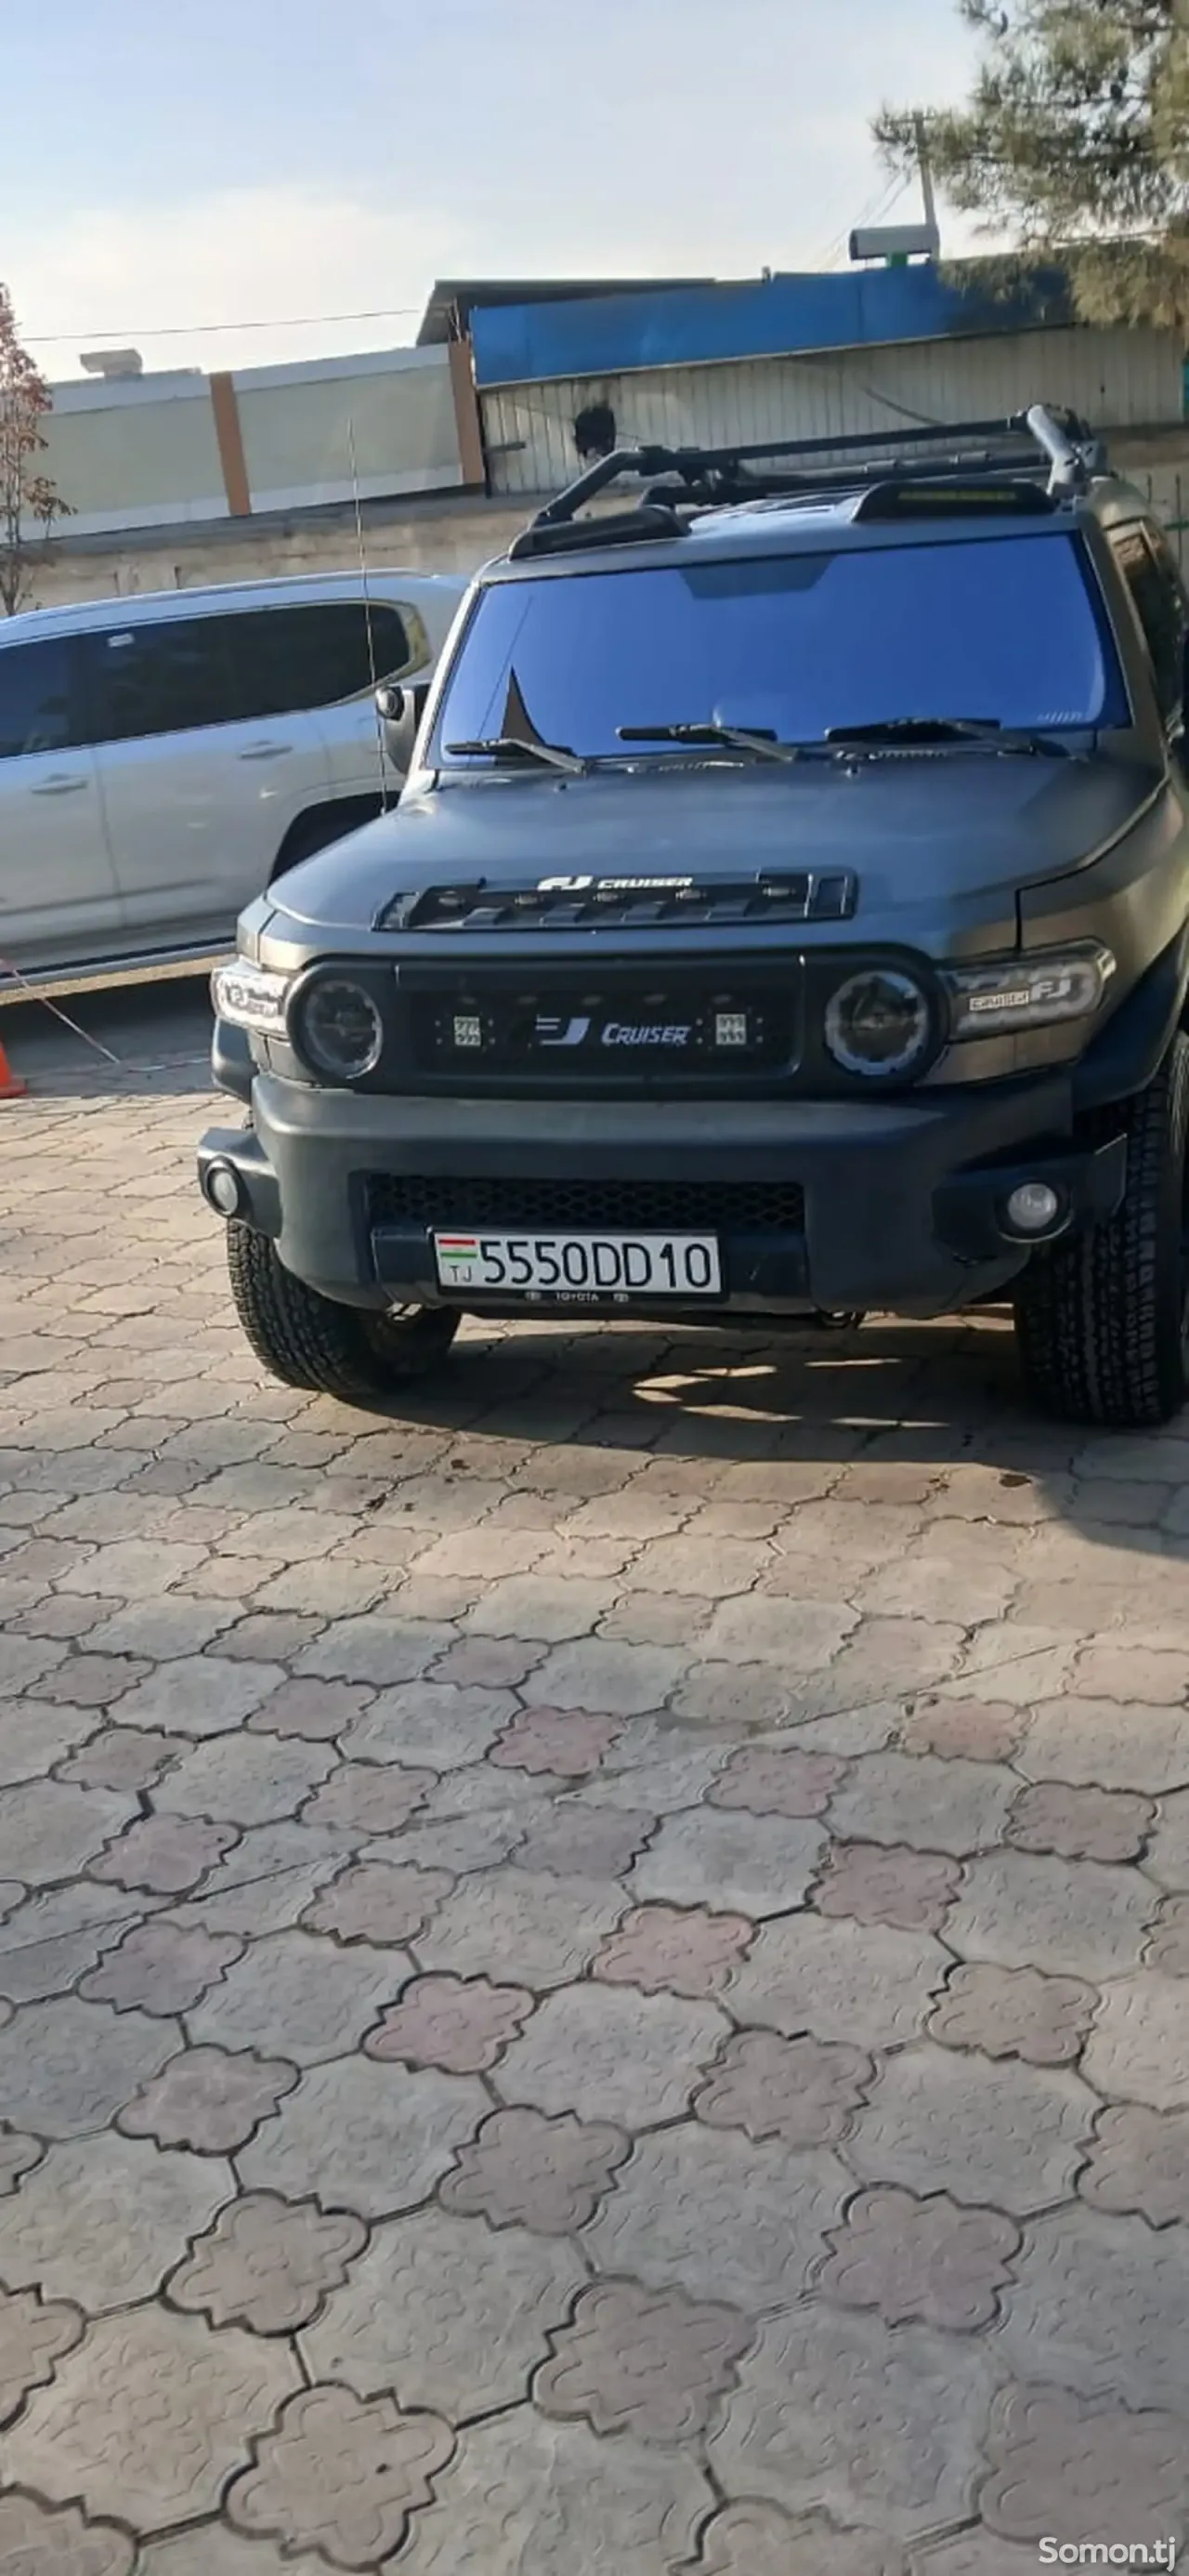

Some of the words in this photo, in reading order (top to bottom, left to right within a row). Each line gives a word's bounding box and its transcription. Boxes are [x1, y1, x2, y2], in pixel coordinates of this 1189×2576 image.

[597, 877, 694, 889] CRUISER
[450, 1265, 472, 1282] TJ
[555, 1292, 599, 1302] TOYOTA
